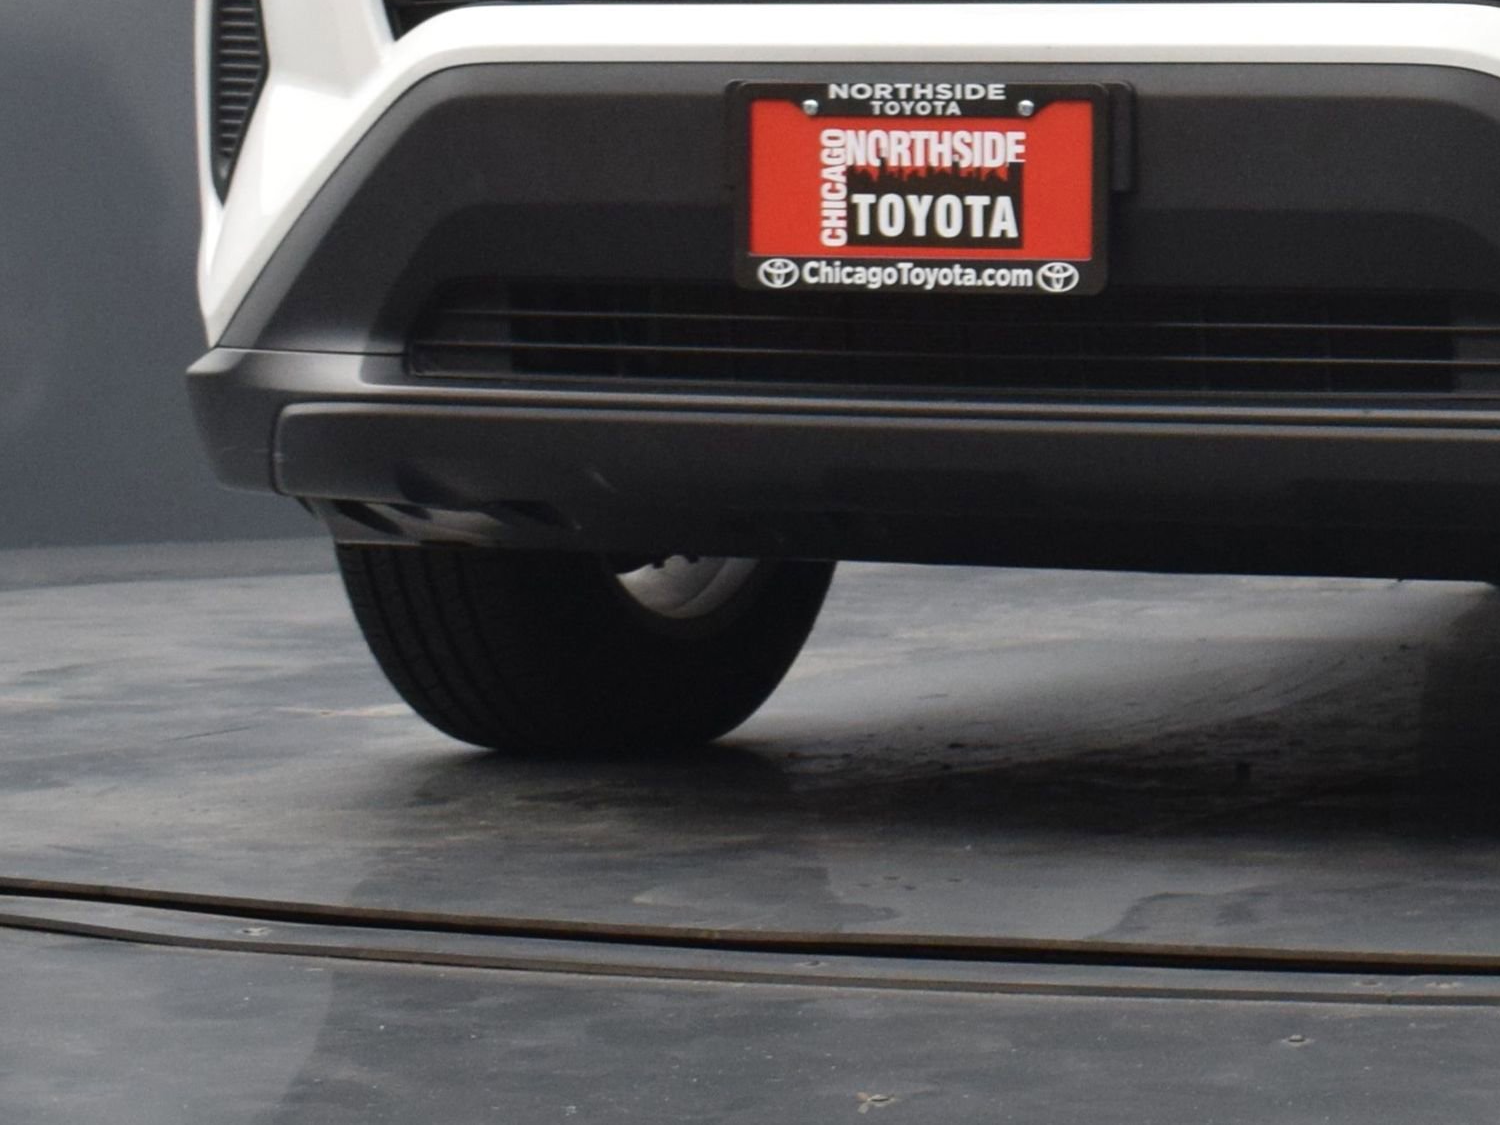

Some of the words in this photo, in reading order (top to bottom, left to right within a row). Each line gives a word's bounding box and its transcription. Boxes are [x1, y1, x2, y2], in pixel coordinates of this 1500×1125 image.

[828, 83, 1006, 99] NORTHSIDE
[871, 101, 961, 115] TOYOTA
[847, 130, 1026, 168] NORTHSIDE
[820, 129, 847, 246] CHICAGO
[852, 194, 1018, 238] TOYOTA
[803, 261, 1033, 289] ChicagoToyota.com
